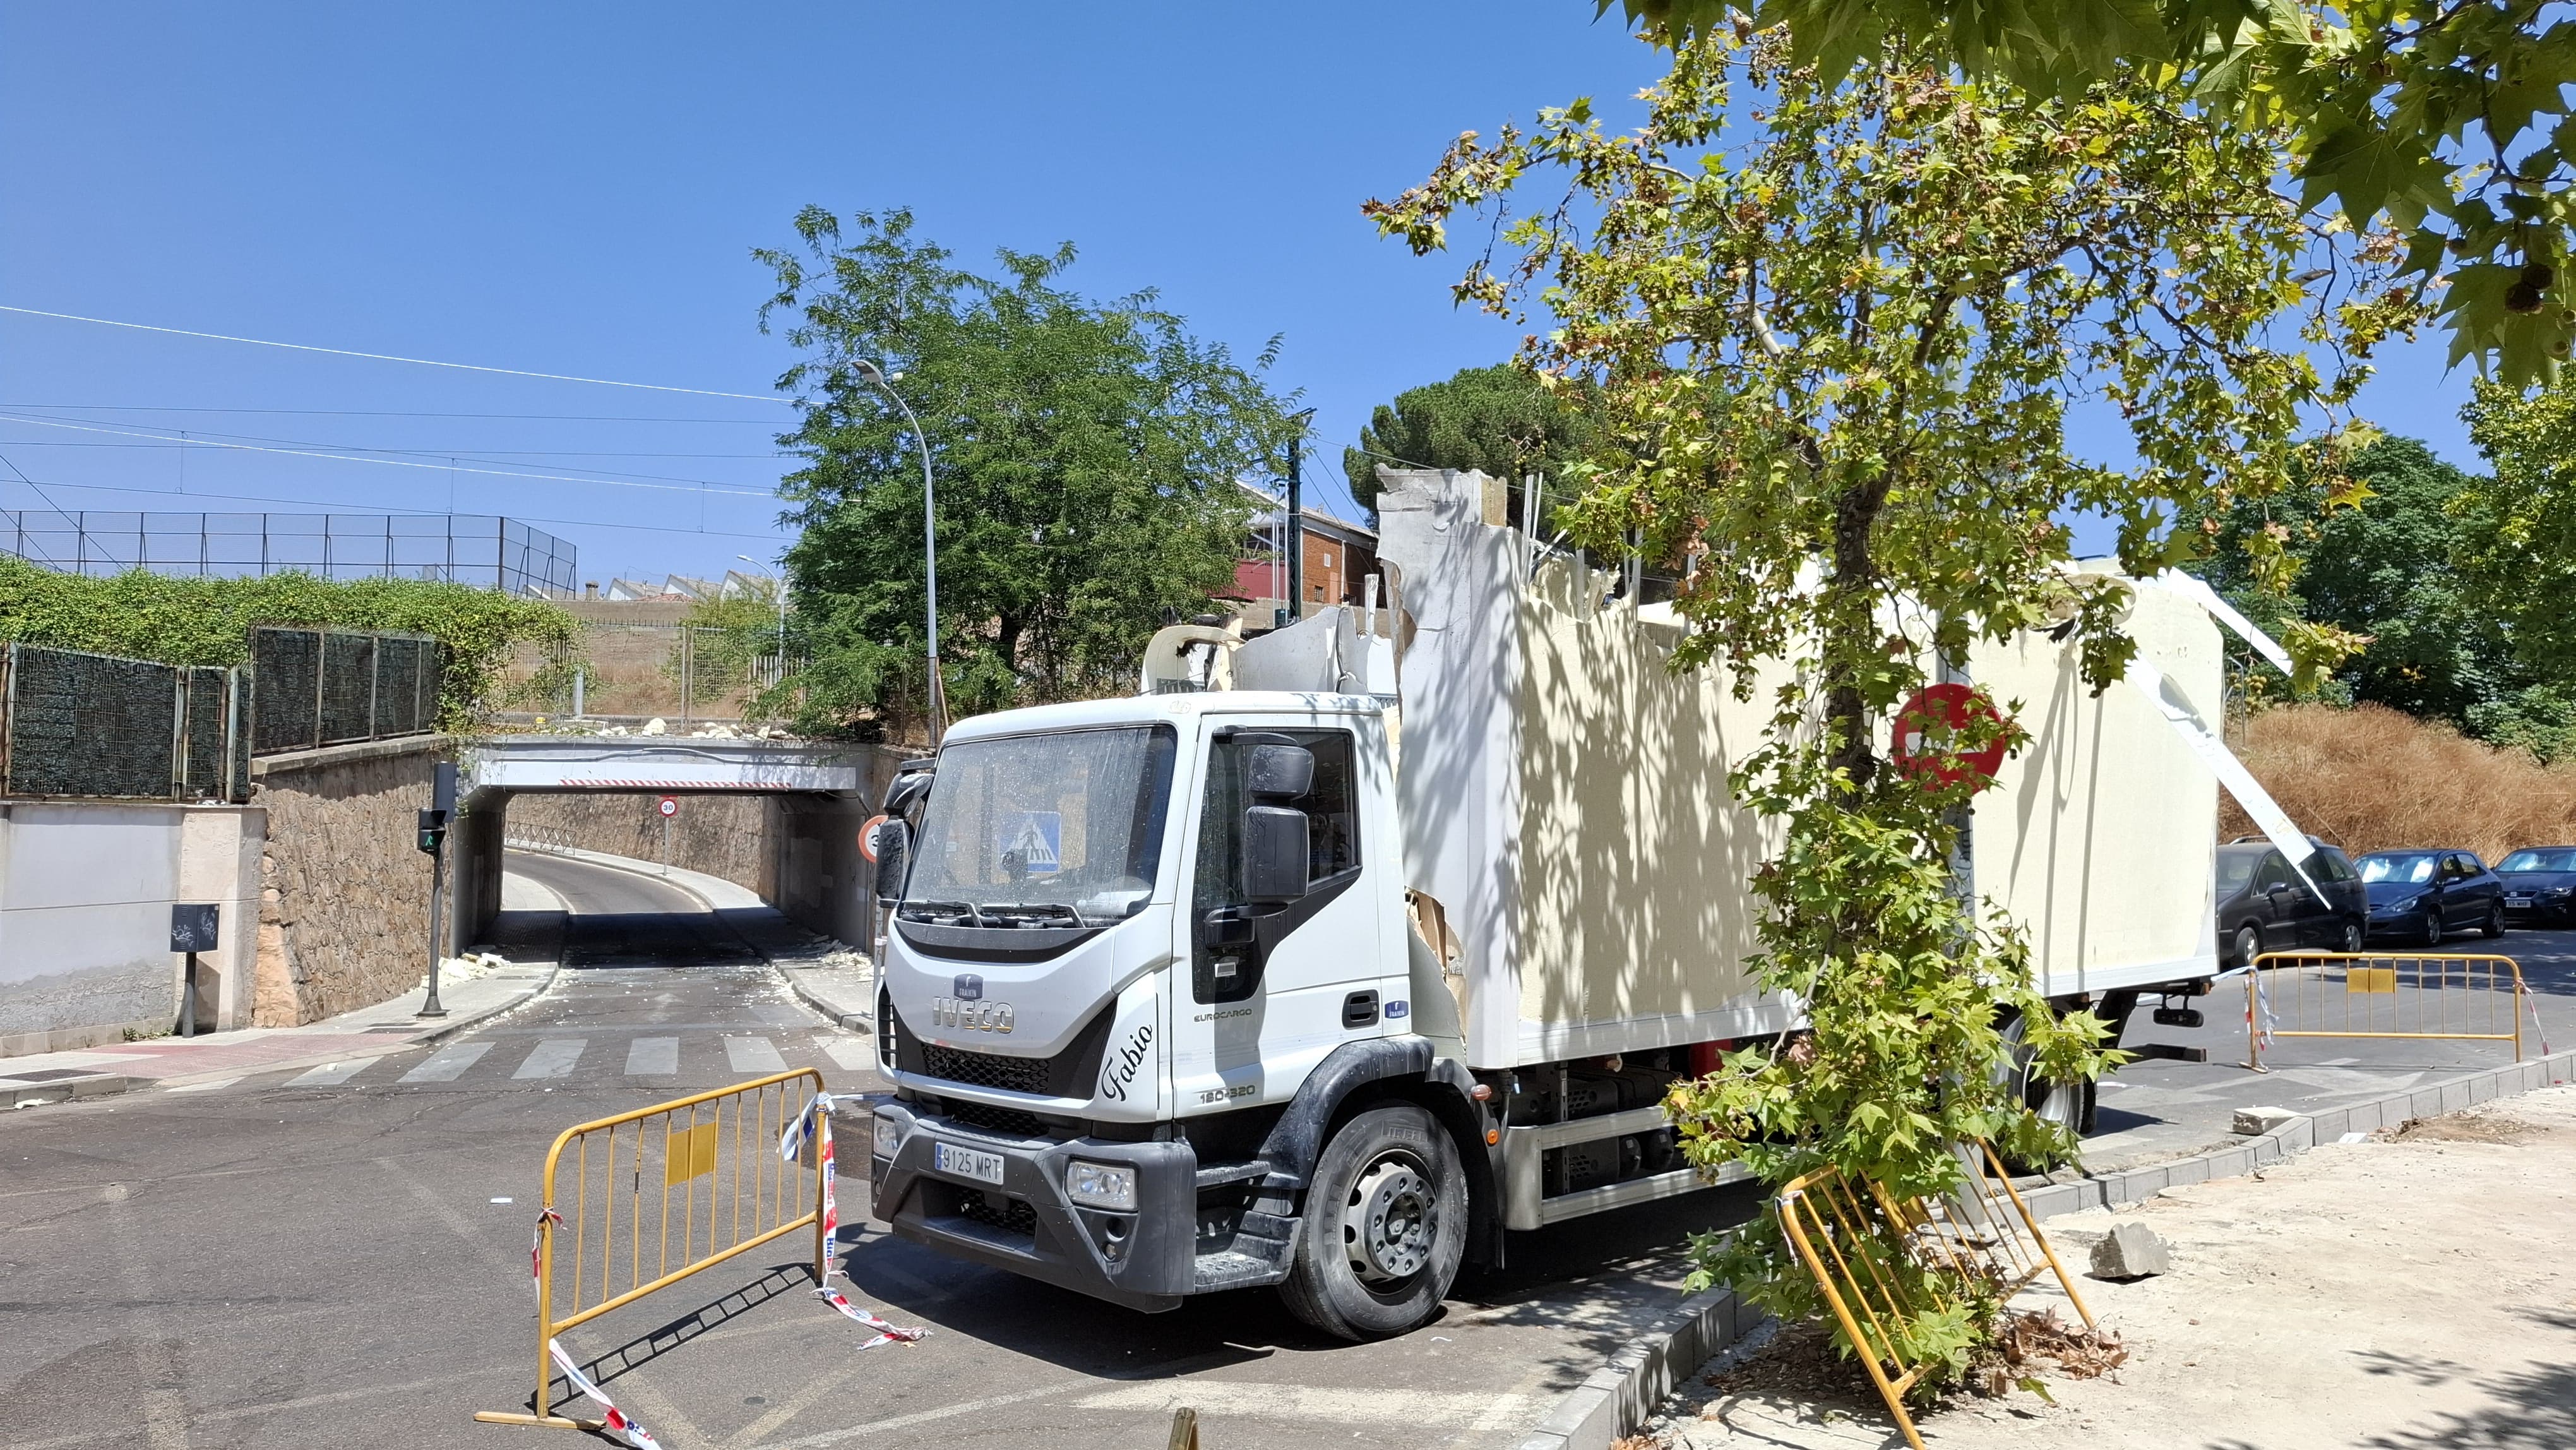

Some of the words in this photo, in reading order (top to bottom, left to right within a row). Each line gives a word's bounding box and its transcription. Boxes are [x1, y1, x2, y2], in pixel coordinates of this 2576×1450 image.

[933, 997, 1015, 1034] IVECO
[1194, 1009, 1252, 1022] EUROCARGO
[1101, 1024, 1152, 1101] Fabio
[943, 1148, 972, 1173] 9125
[976, 1155, 1000, 1180] MRT
